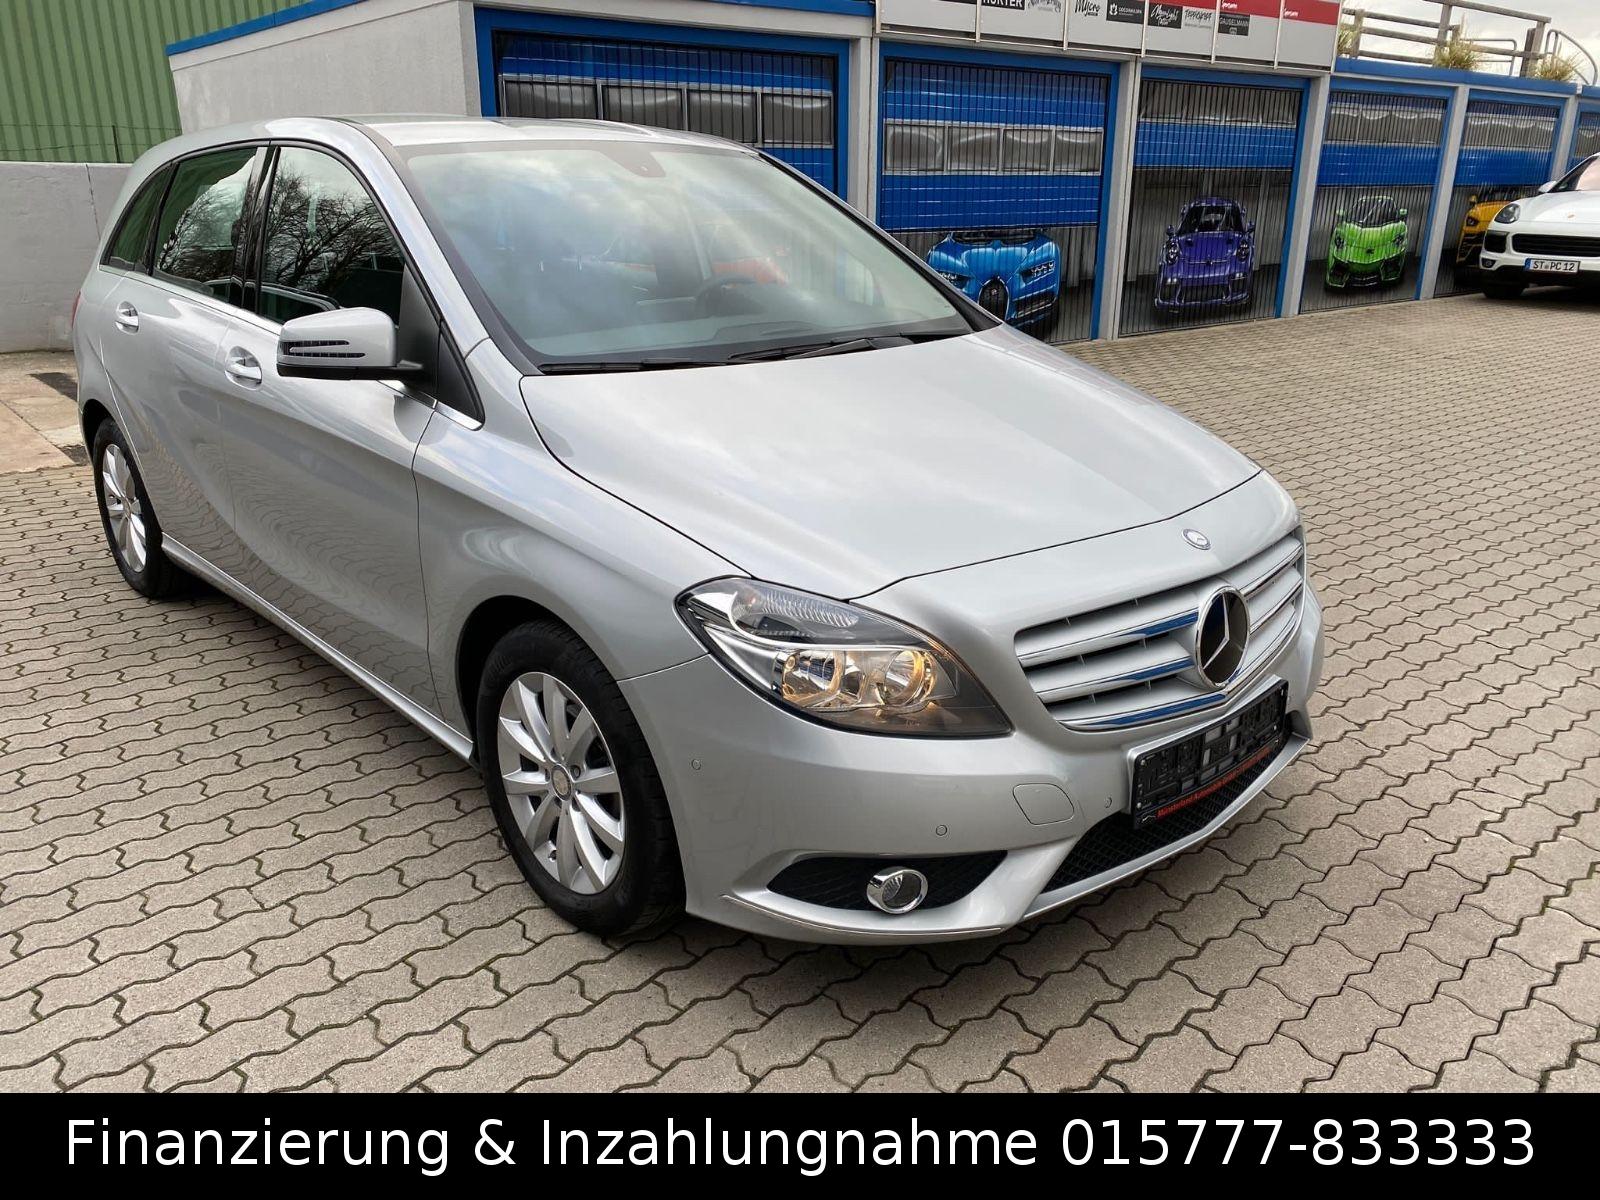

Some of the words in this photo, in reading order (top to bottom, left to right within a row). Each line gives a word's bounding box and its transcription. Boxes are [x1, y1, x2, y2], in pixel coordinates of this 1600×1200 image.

[1533, 261, 1545, 269] ST
[1549, 262, 1561, 270] PC
[1563, 263, 1575, 271] 12
